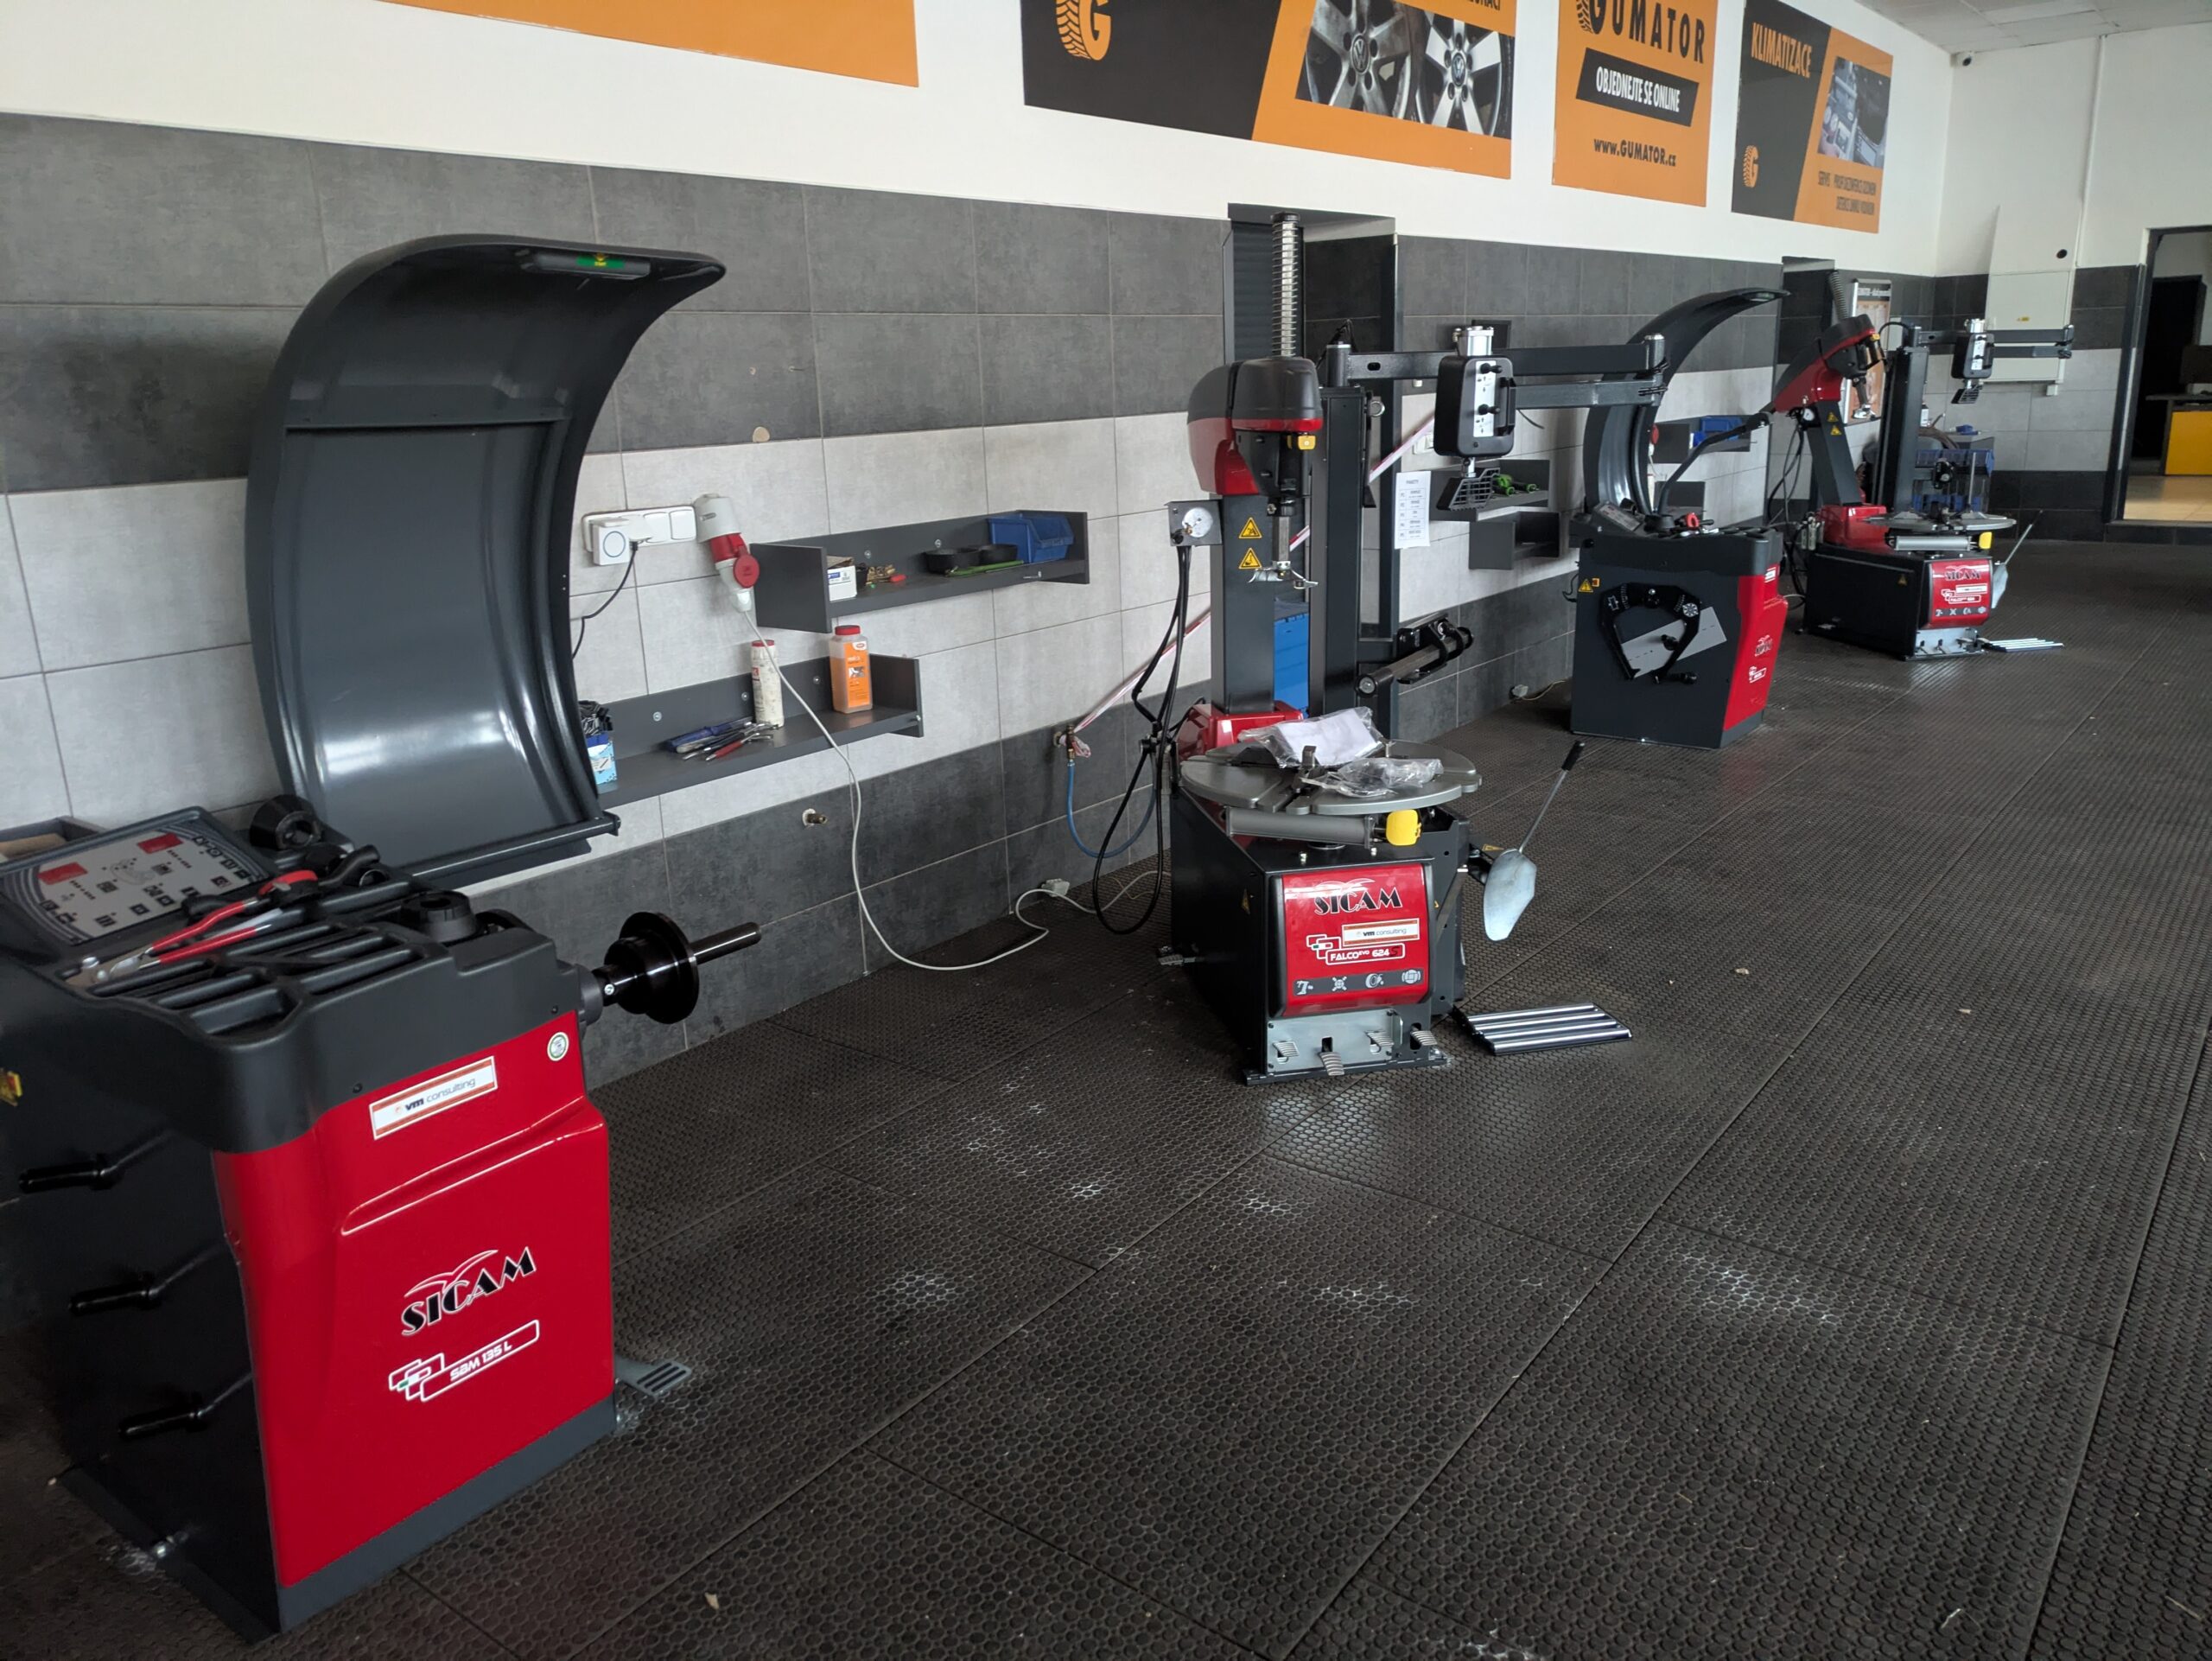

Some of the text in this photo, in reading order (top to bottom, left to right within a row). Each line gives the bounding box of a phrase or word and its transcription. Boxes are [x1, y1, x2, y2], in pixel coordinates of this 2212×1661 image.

[1751, 22, 1812, 79] KLIMATIZACE
[1596, 67, 1681, 112] OBJEDNEJTE SE ONLINE
[1593, 138, 1676, 167] www.GUMATOR.cz
[1314, 887, 1403, 915] SICAM
[1371, 948, 1390, 958] 624
[405, 1078, 476, 1111] vm consulting
[401, 1246, 537, 1336] SICAM
[449, 1340, 512, 1382] SBM 135 L
